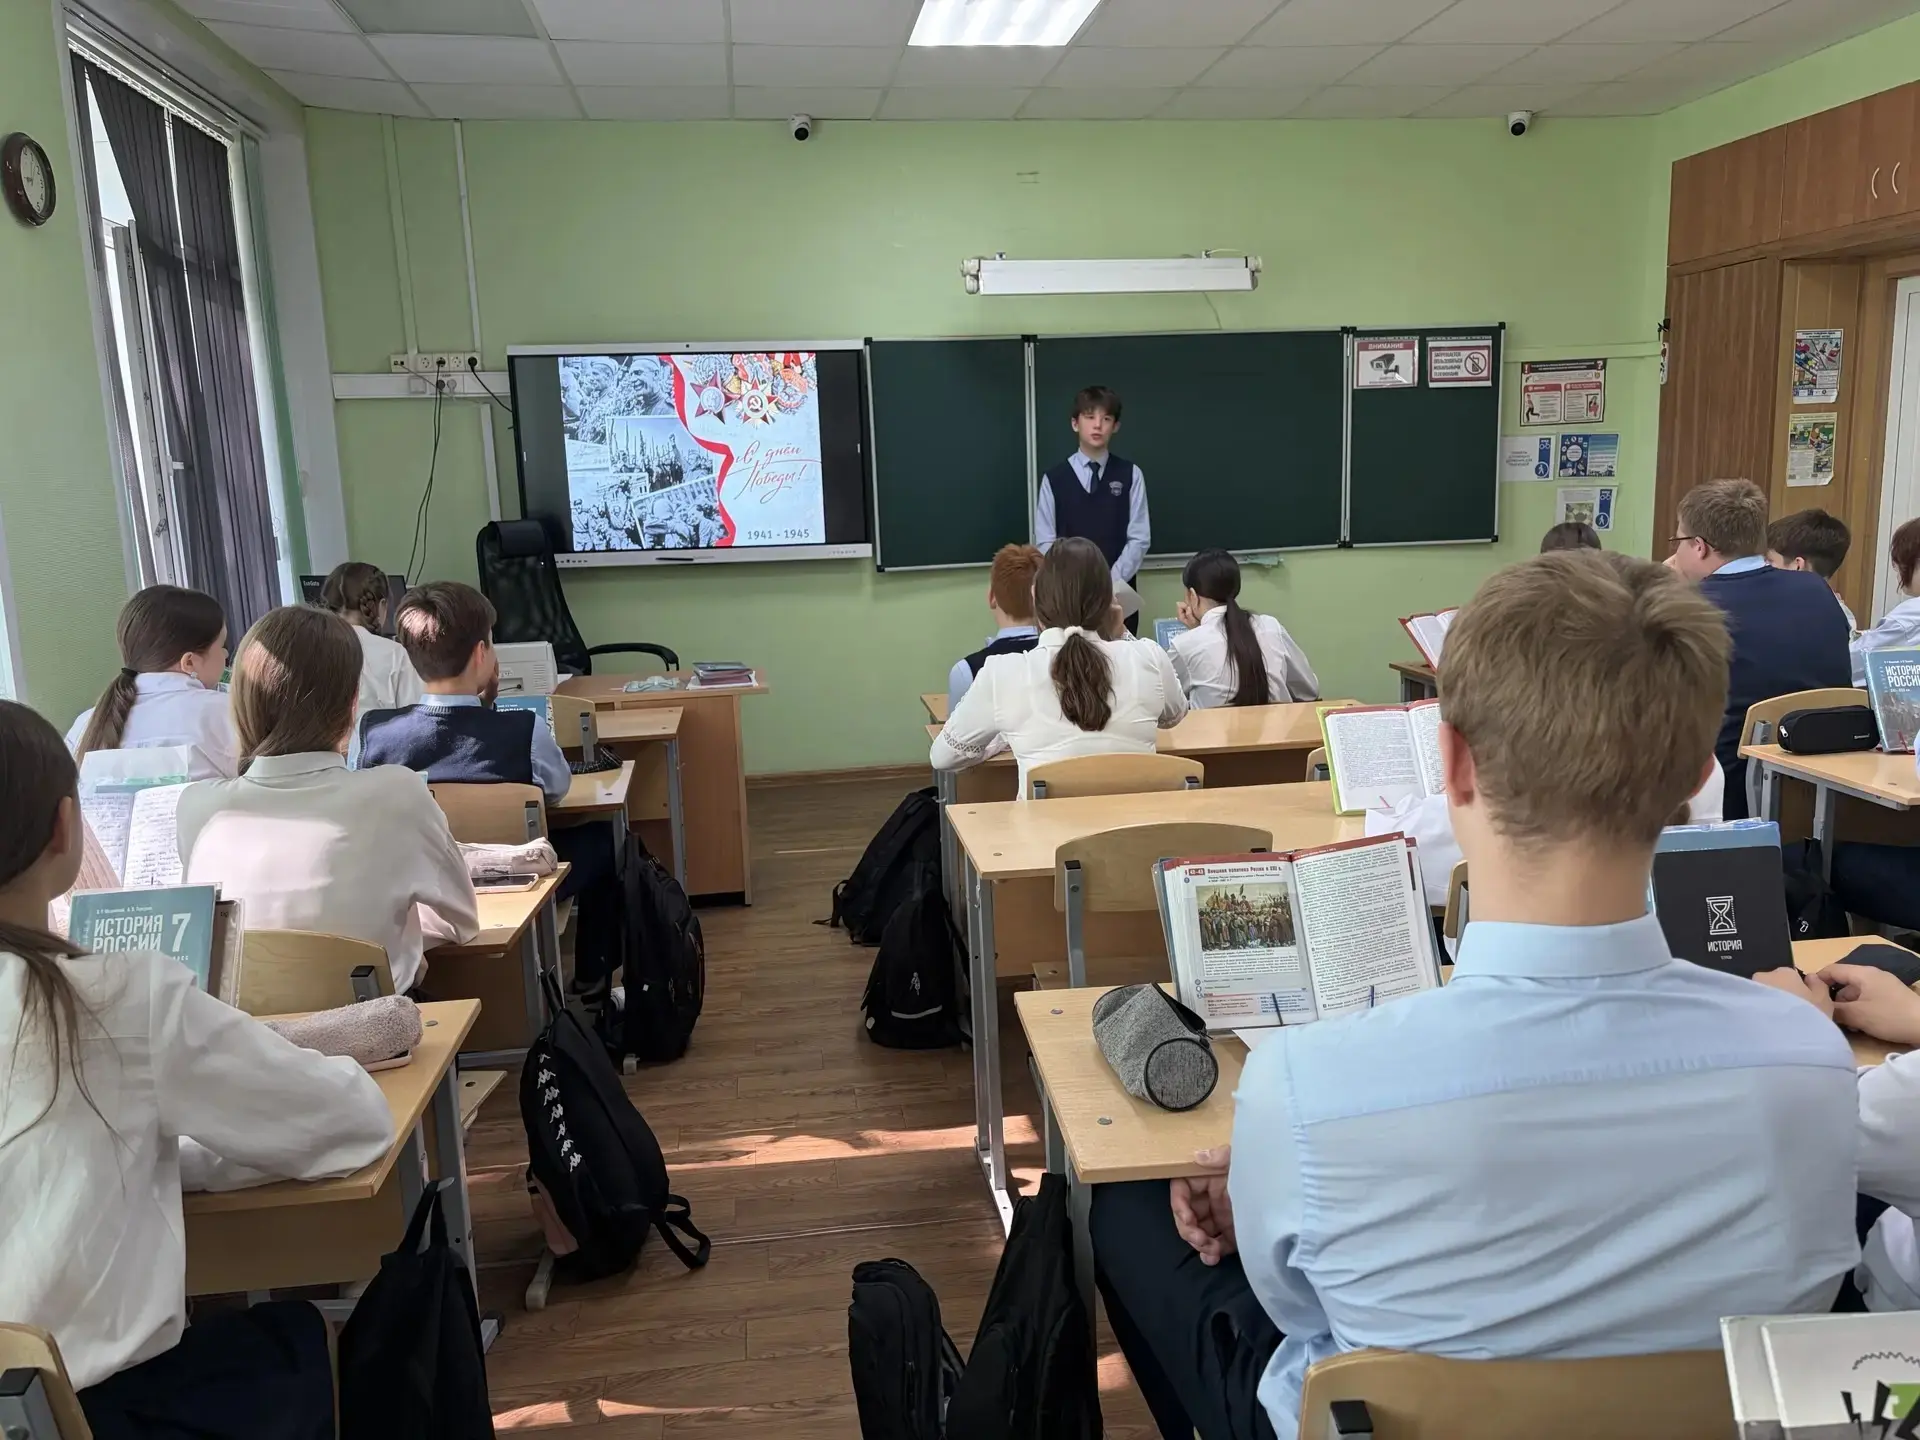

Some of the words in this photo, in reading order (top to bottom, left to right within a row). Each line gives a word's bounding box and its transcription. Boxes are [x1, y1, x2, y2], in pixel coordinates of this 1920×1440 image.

[747, 531, 773, 539] 1941
[784, 529, 810, 538] 1945
[94, 914, 163, 936] ИСТОРИЯ
[172, 912, 191, 953] 7
[1707, 940, 1743, 952] ИСТОРИЯ
